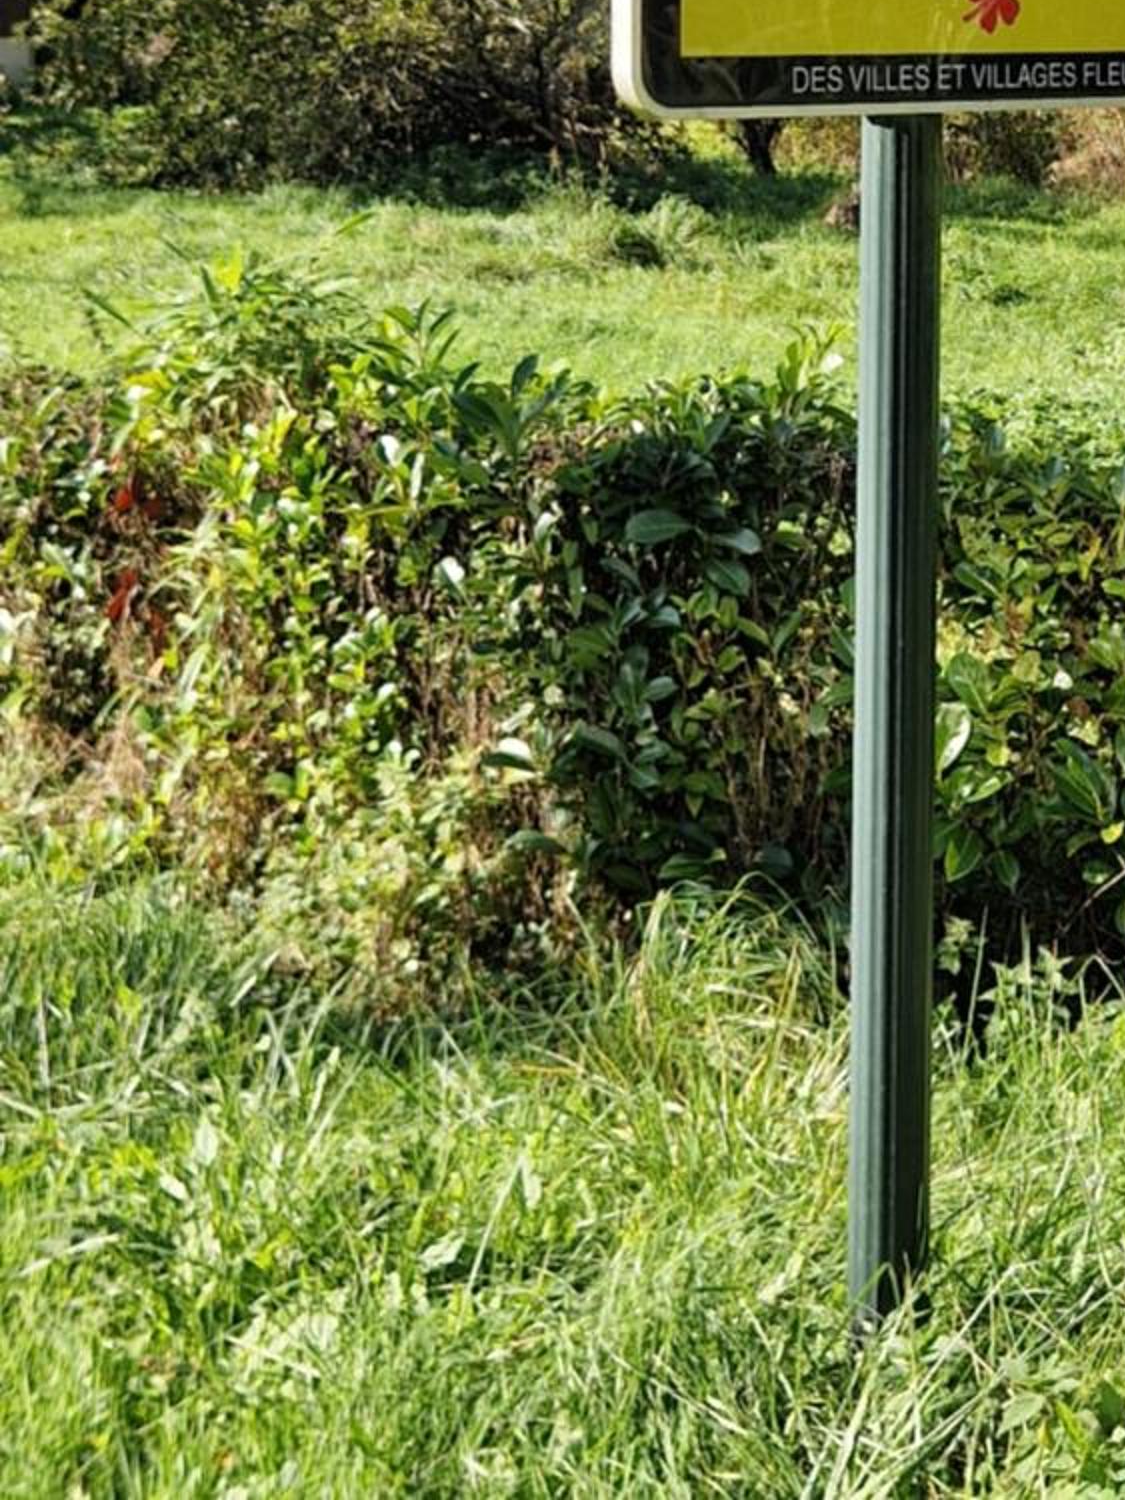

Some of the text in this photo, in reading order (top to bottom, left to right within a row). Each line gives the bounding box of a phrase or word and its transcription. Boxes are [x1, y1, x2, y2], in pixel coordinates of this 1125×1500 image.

[792, 65, 843, 94] DES
[848, 63, 930, 92] VILLES
[935, 64, 967, 91] ET
[970, 61, 1077, 90] VILLAGES
